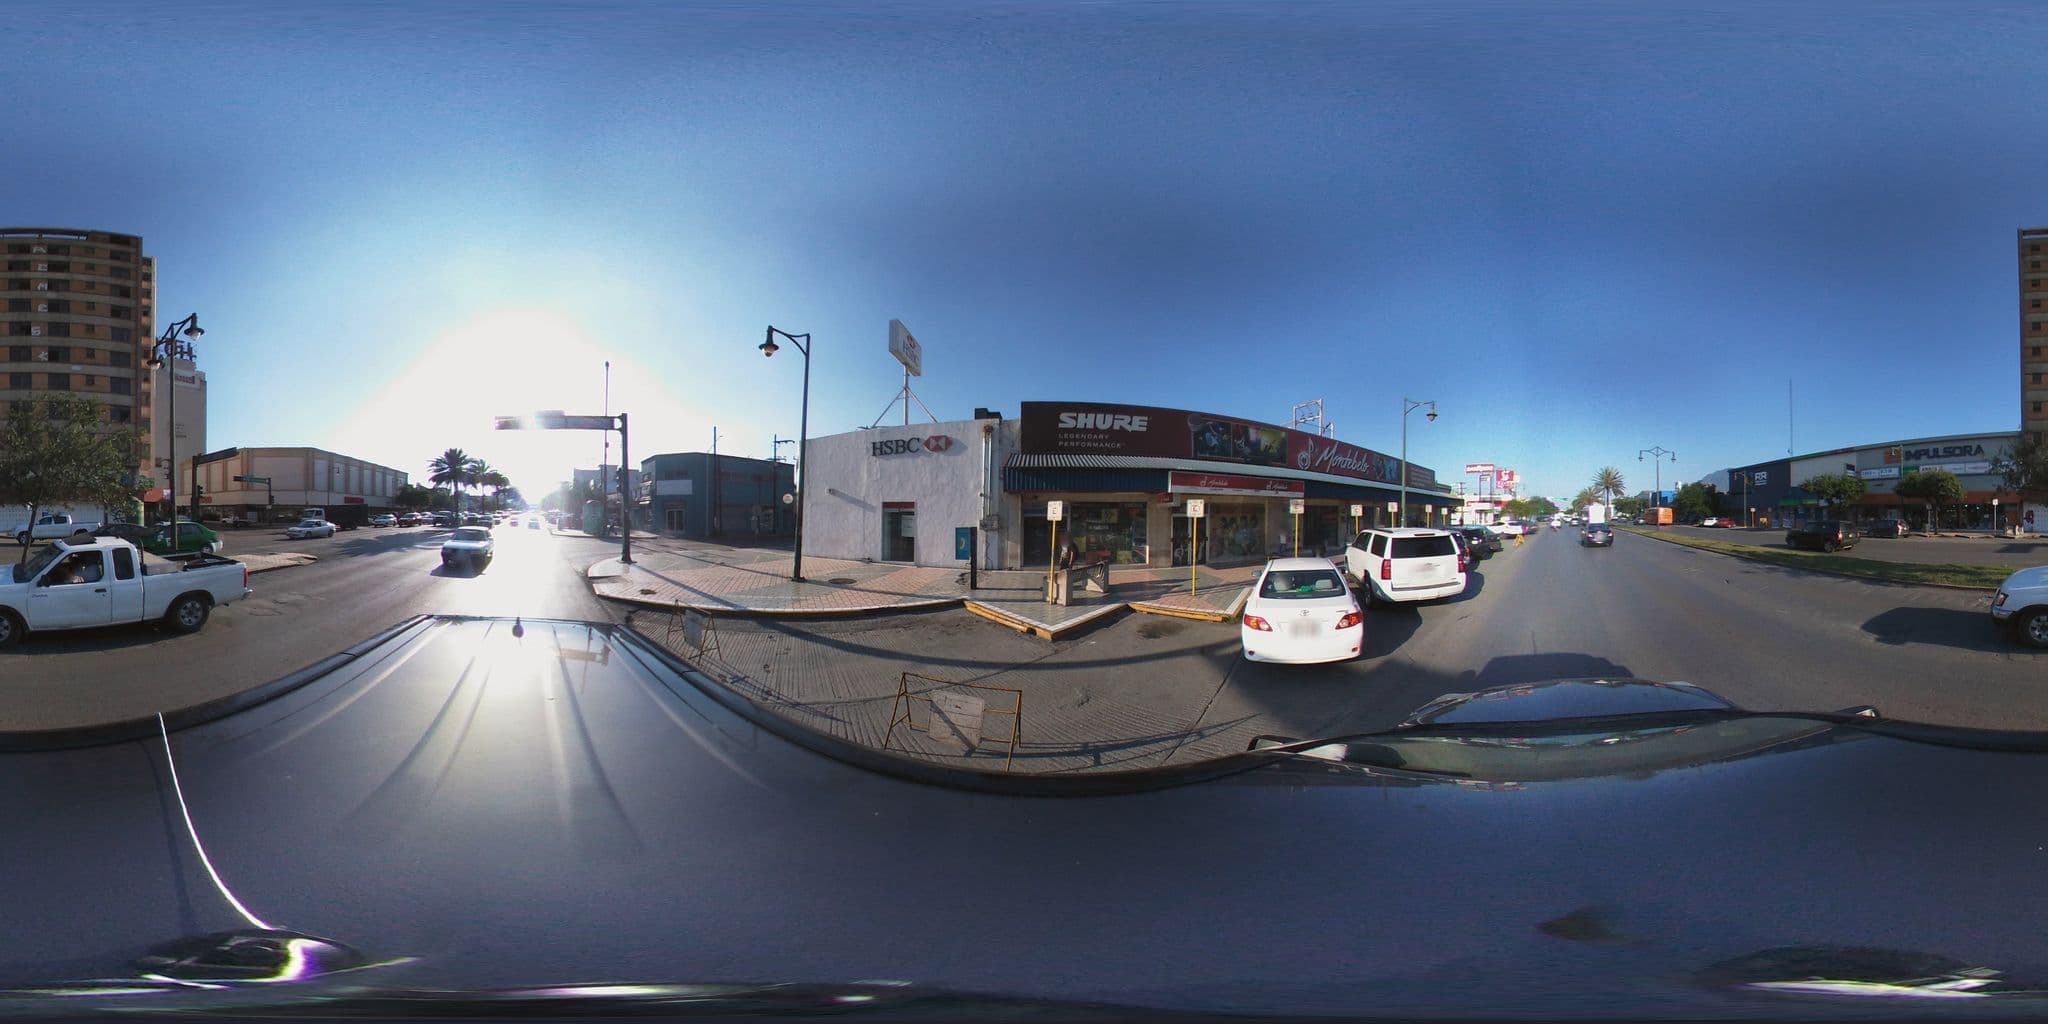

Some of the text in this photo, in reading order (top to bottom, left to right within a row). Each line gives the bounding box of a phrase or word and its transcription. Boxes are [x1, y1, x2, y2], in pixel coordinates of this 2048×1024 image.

[1058, 412, 1148, 432] SHURE
[872, 437, 921, 456] HSBC
[1058, 441, 1122, 449] PERFORMANCE
[1905, 444, 1985, 461] IMPULSORA
